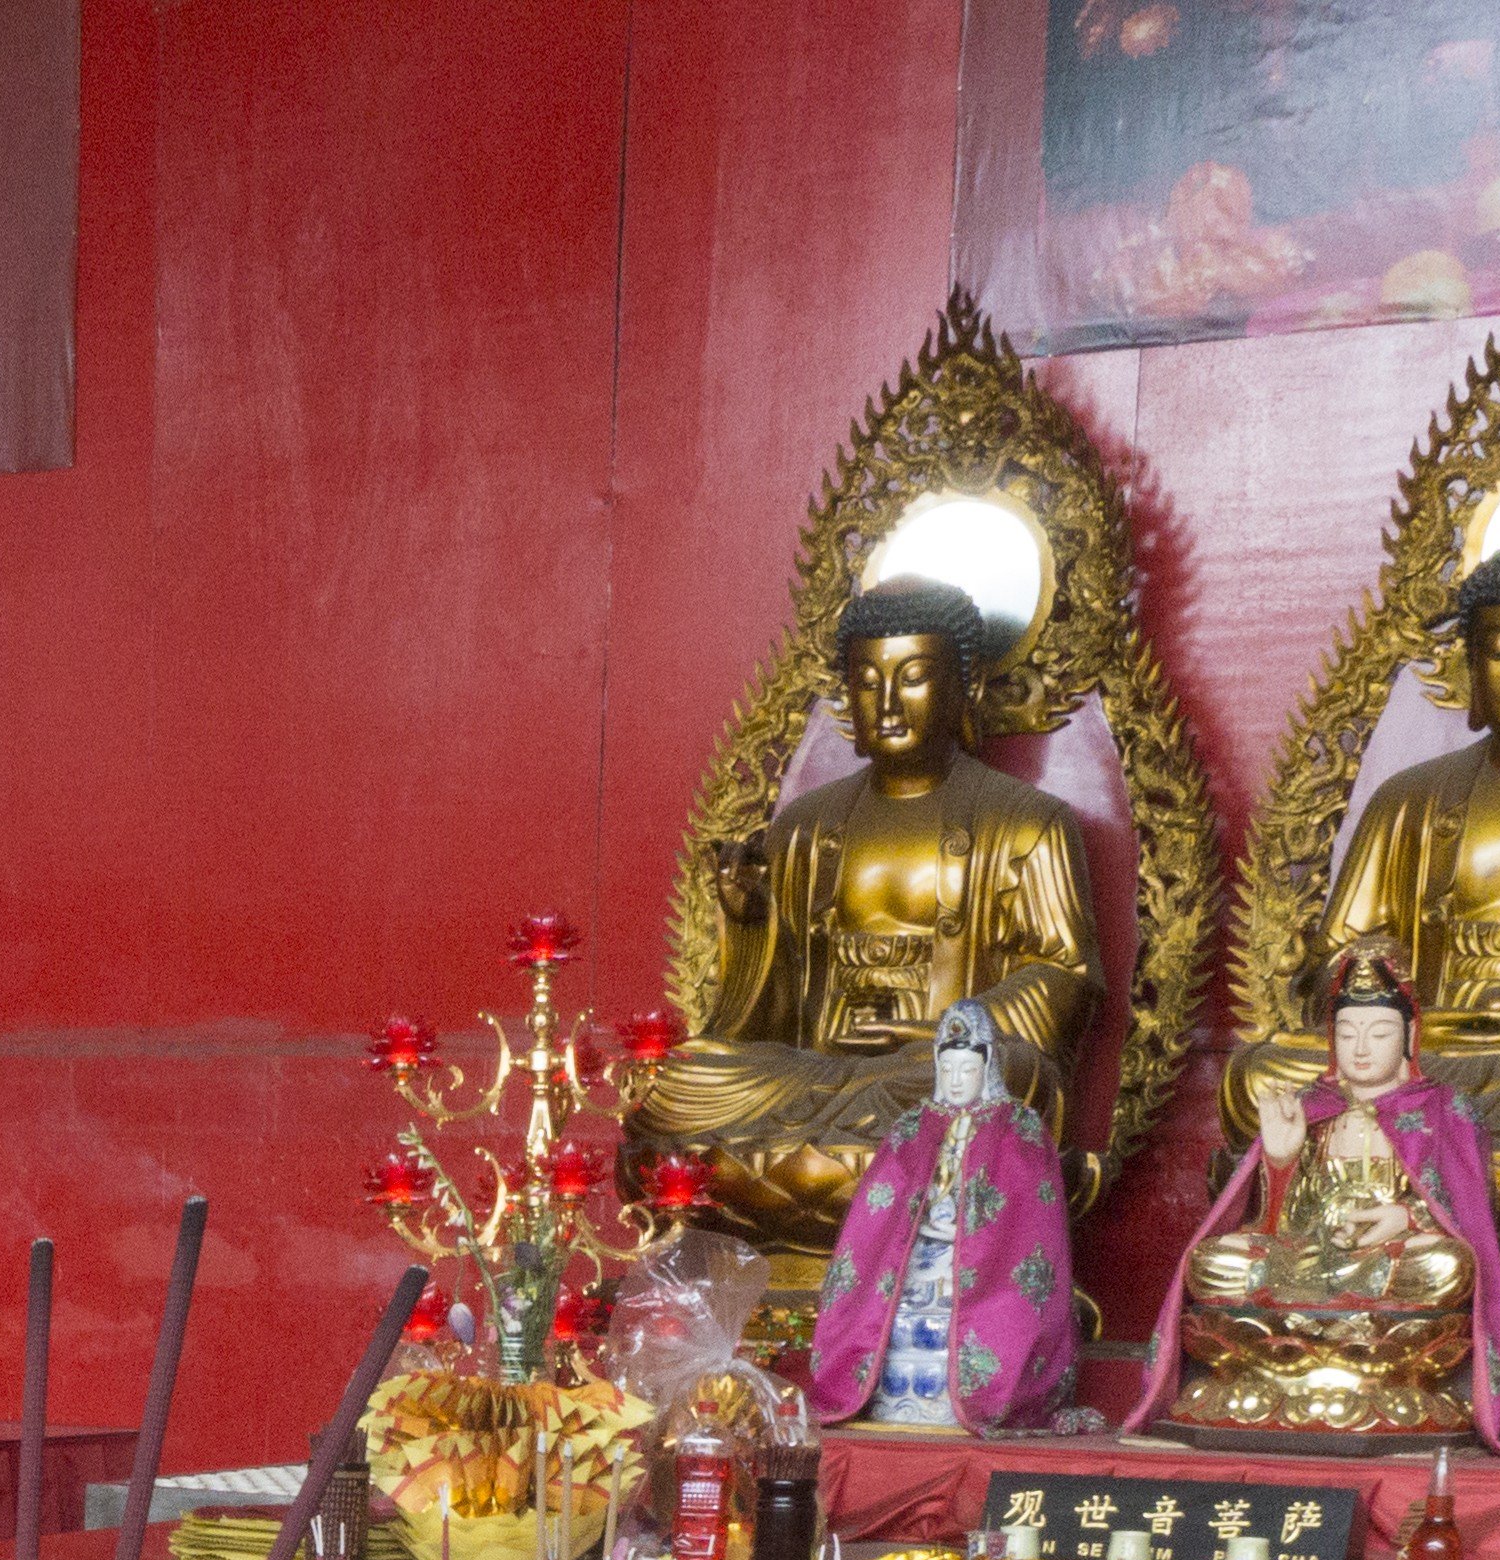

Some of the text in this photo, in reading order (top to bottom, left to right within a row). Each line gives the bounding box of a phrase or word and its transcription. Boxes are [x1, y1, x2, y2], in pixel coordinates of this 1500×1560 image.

[1003, 1490, 1323, 1543] 观世音菩萨
[1151, 1548, 1173, 1560] M
